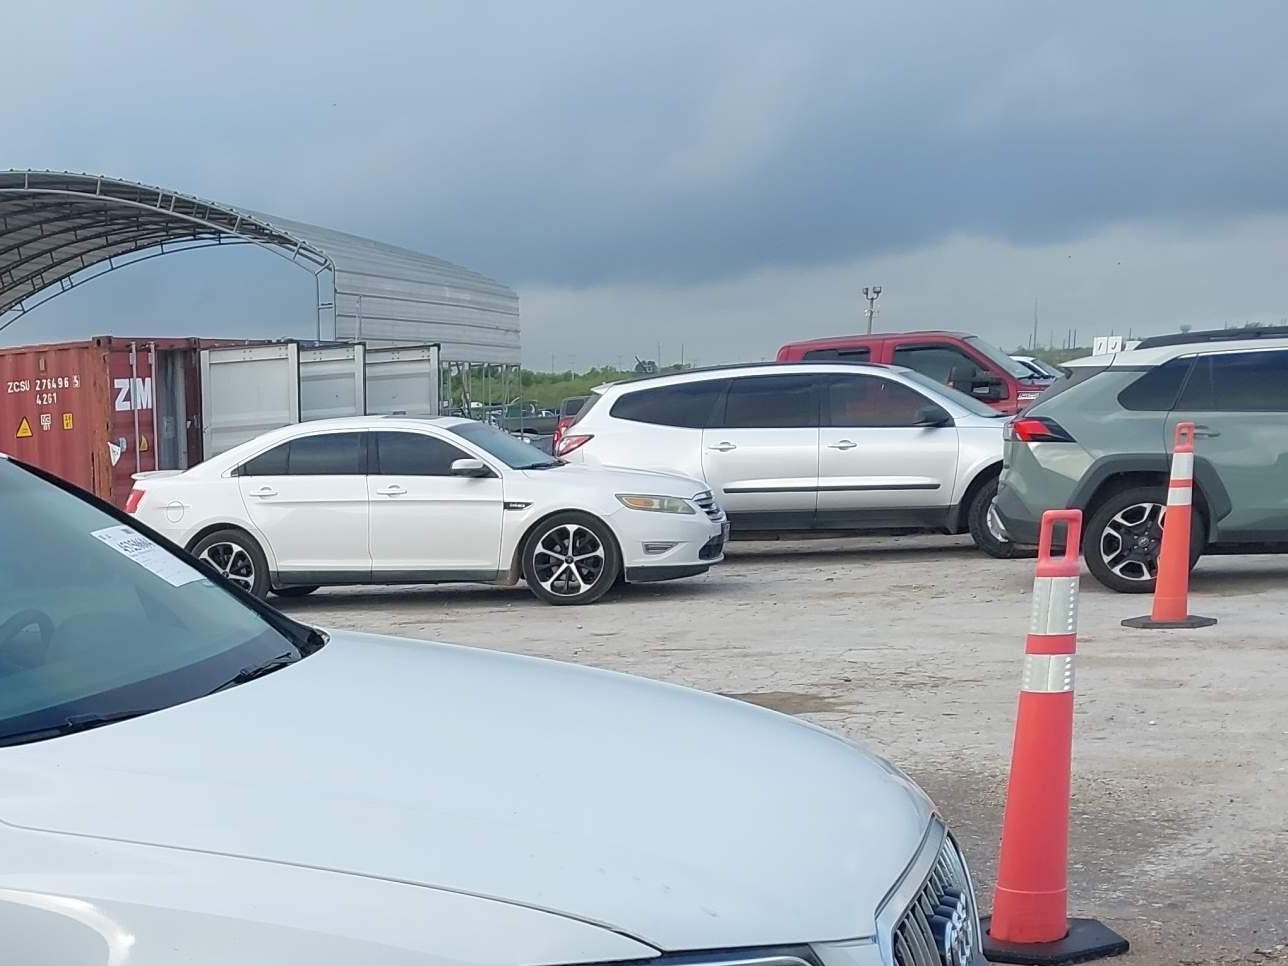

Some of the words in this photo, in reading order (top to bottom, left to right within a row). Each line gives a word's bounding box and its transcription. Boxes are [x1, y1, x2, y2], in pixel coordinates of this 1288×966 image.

[8, 380, 30, 393] ZCSU
[35, 377, 69, 390] 276496
[114, 377, 152, 411] ZIM
